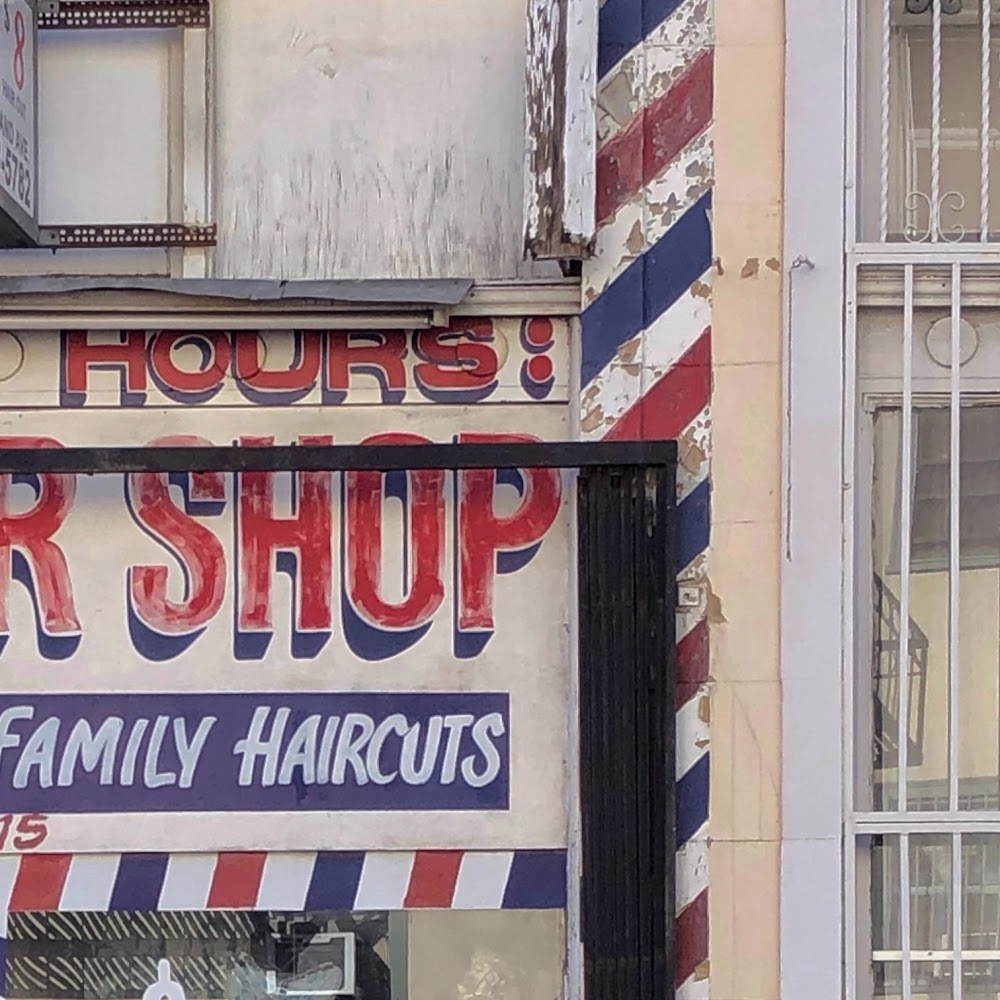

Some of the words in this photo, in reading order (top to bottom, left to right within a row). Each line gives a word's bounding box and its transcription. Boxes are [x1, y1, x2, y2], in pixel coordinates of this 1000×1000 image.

[60, 318, 499, 406] HOURS
[124, 433, 562, 661] SHOP
[233, 705, 505, 788] HAIRCUTS
